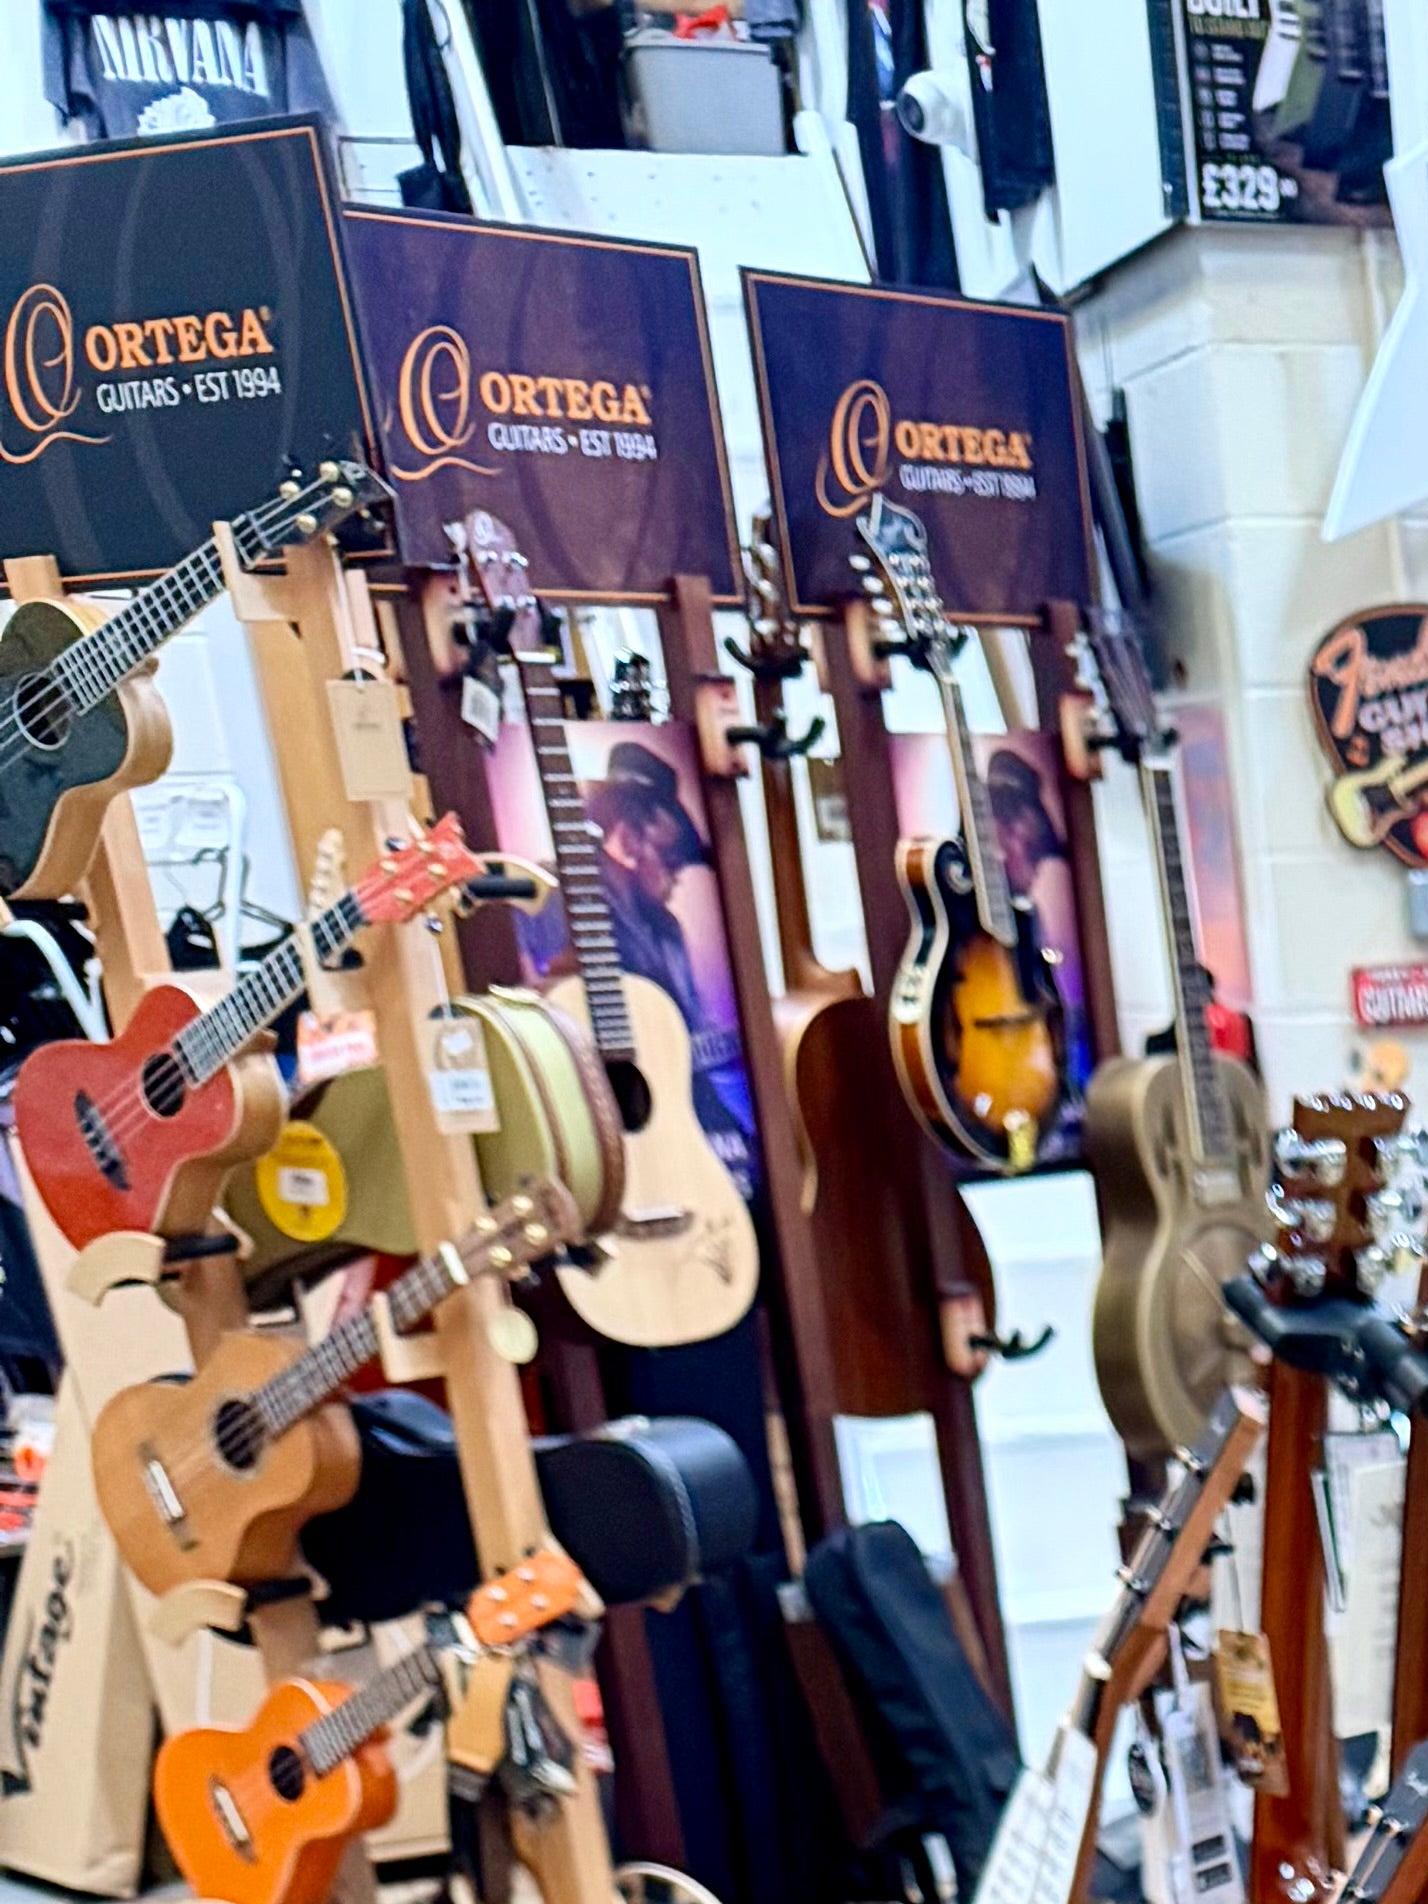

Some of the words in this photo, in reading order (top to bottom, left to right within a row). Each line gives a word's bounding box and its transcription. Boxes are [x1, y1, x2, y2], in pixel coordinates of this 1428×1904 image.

[98, 14, 270, 97] NIRVANA
[86, 308, 272, 372] ORTEGA
[96, 375, 179, 412] GUITARS
[196, 372, 231, 403] EST
[236, 367, 281, 398] 1994
[480, 373, 650, 427] ORTEGA
[487, 422, 564, 455] GUITARS
[580, 427, 612, 456] EST
[615, 428, 657, 460] 1994
[896, 420, 1030, 468] ORTEGA
[899, 464, 962, 492] GUITARS
[1002, 470, 1036, 502] 1994
